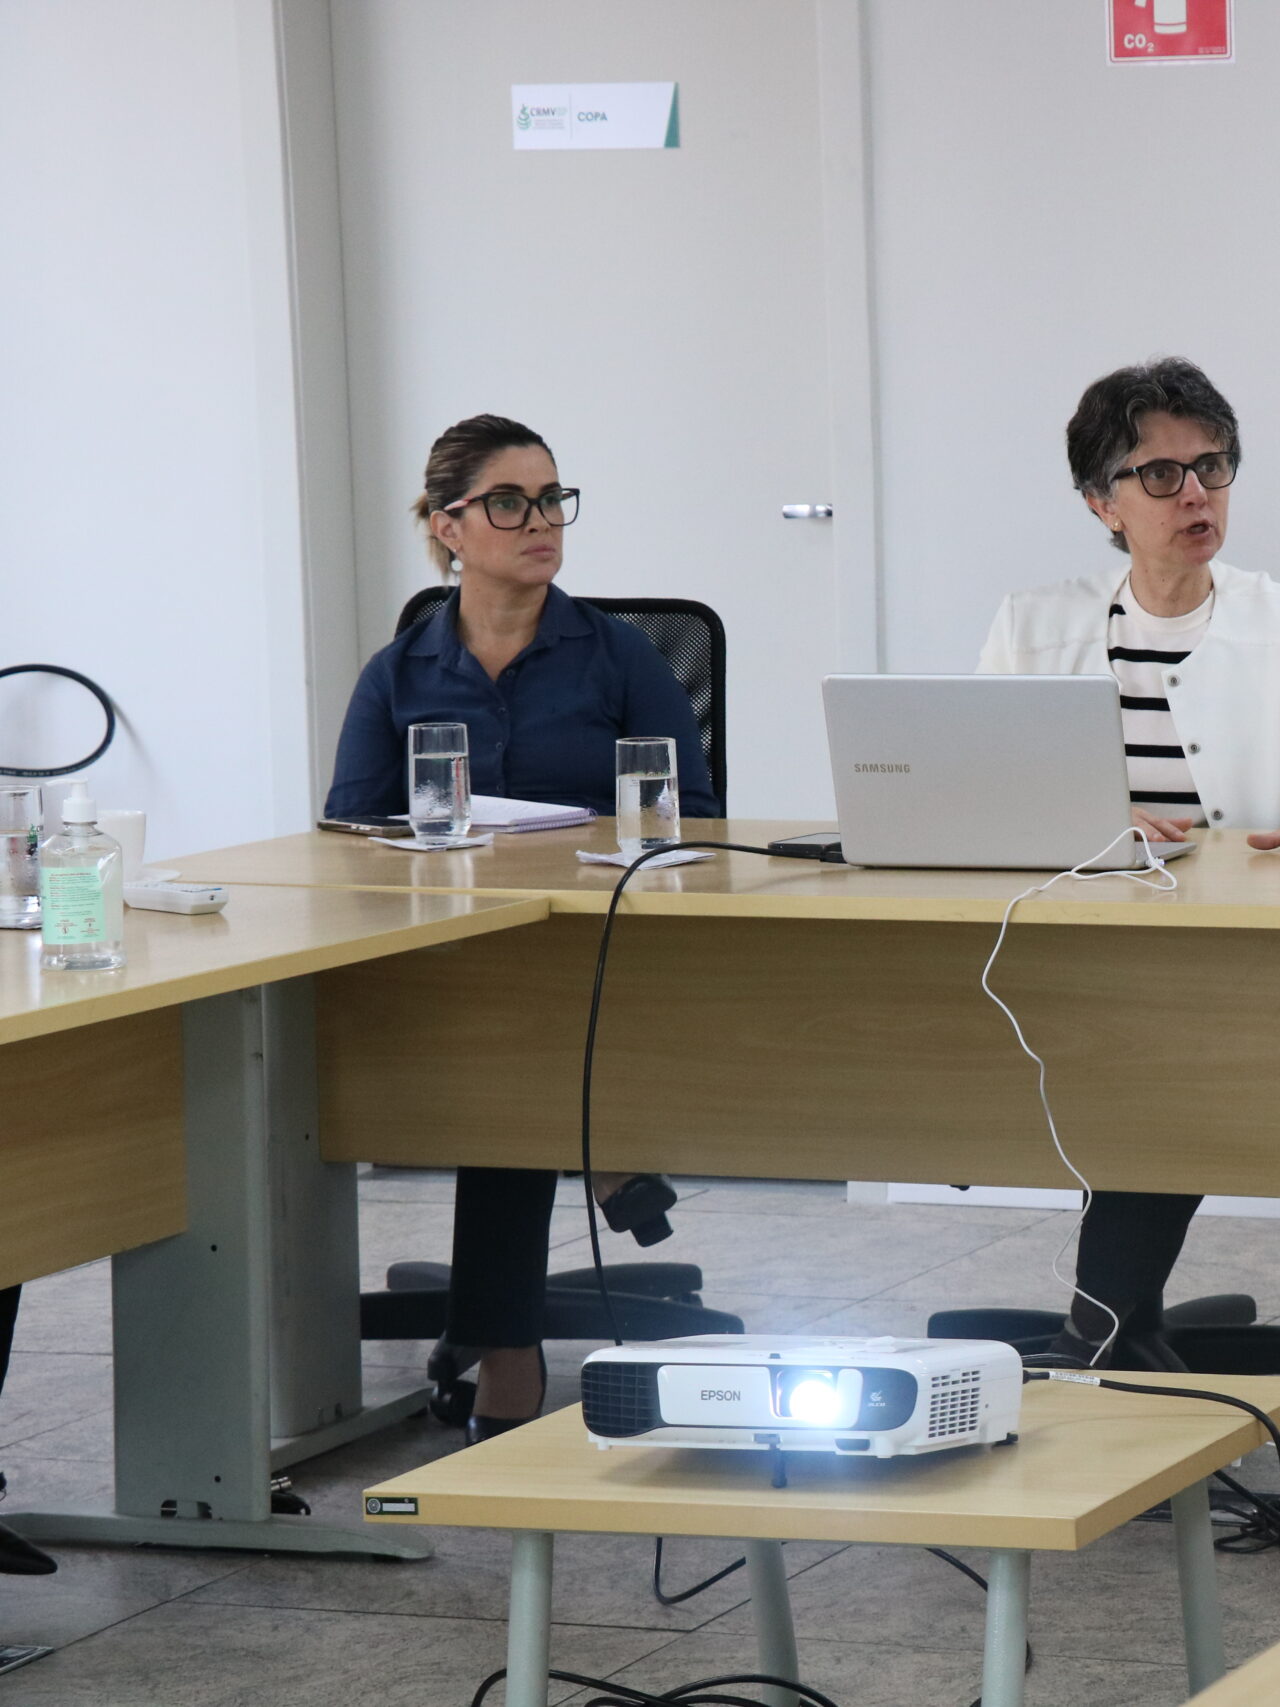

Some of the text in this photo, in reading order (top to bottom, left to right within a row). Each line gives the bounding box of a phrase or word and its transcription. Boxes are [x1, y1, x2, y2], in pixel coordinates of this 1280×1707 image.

[577, 111, 608, 122] COPA
[854, 763, 911, 774] SAMSUNG
[700, 1389, 741, 1402] EPSON
